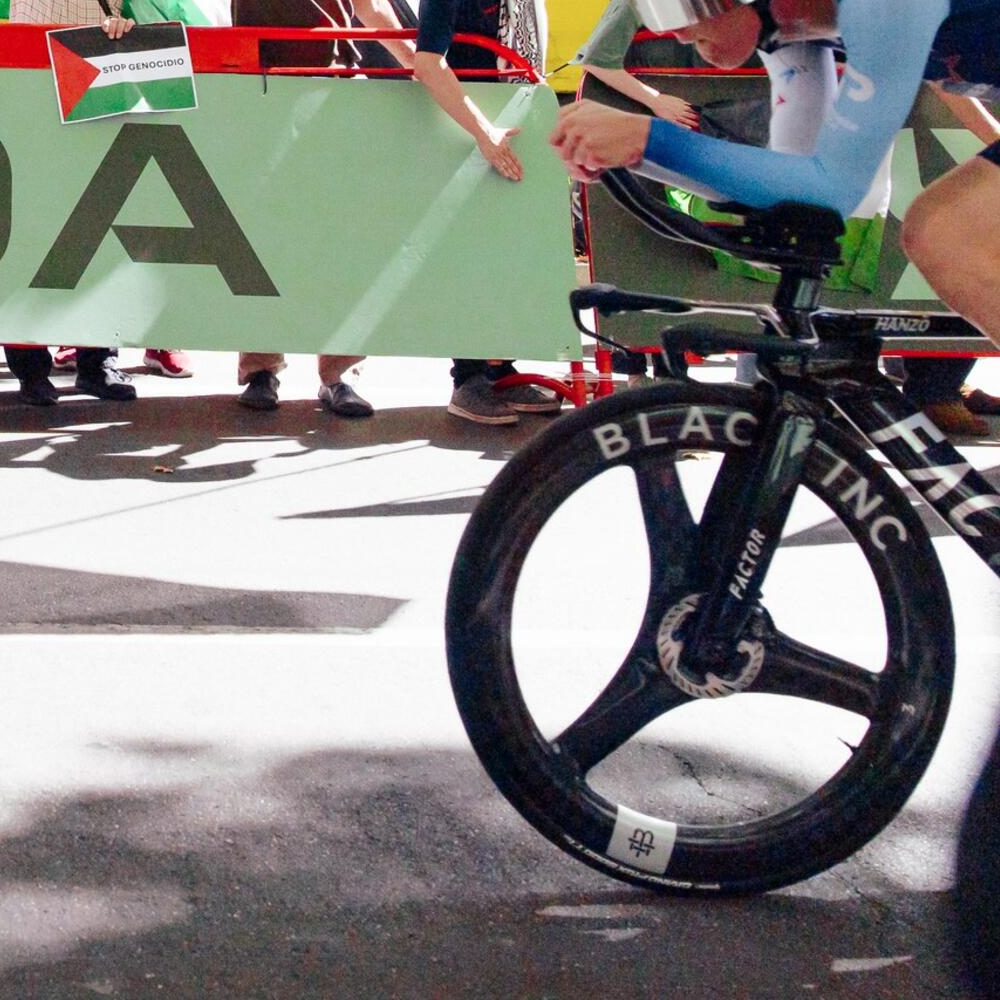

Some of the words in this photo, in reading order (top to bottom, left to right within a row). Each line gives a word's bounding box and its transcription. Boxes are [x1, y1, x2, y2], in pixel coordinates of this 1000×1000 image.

[102, 63, 127, 74] STOP
[128, 57, 184, 71] GENOCIDIO
[874, 316, 931, 332] HANZO
[593, 405, 760, 460] BLAC
[821, 458, 908, 551] INC
[869, 411, 1000, 538] FAC
[728, 528, 766, 600] FACTOR
